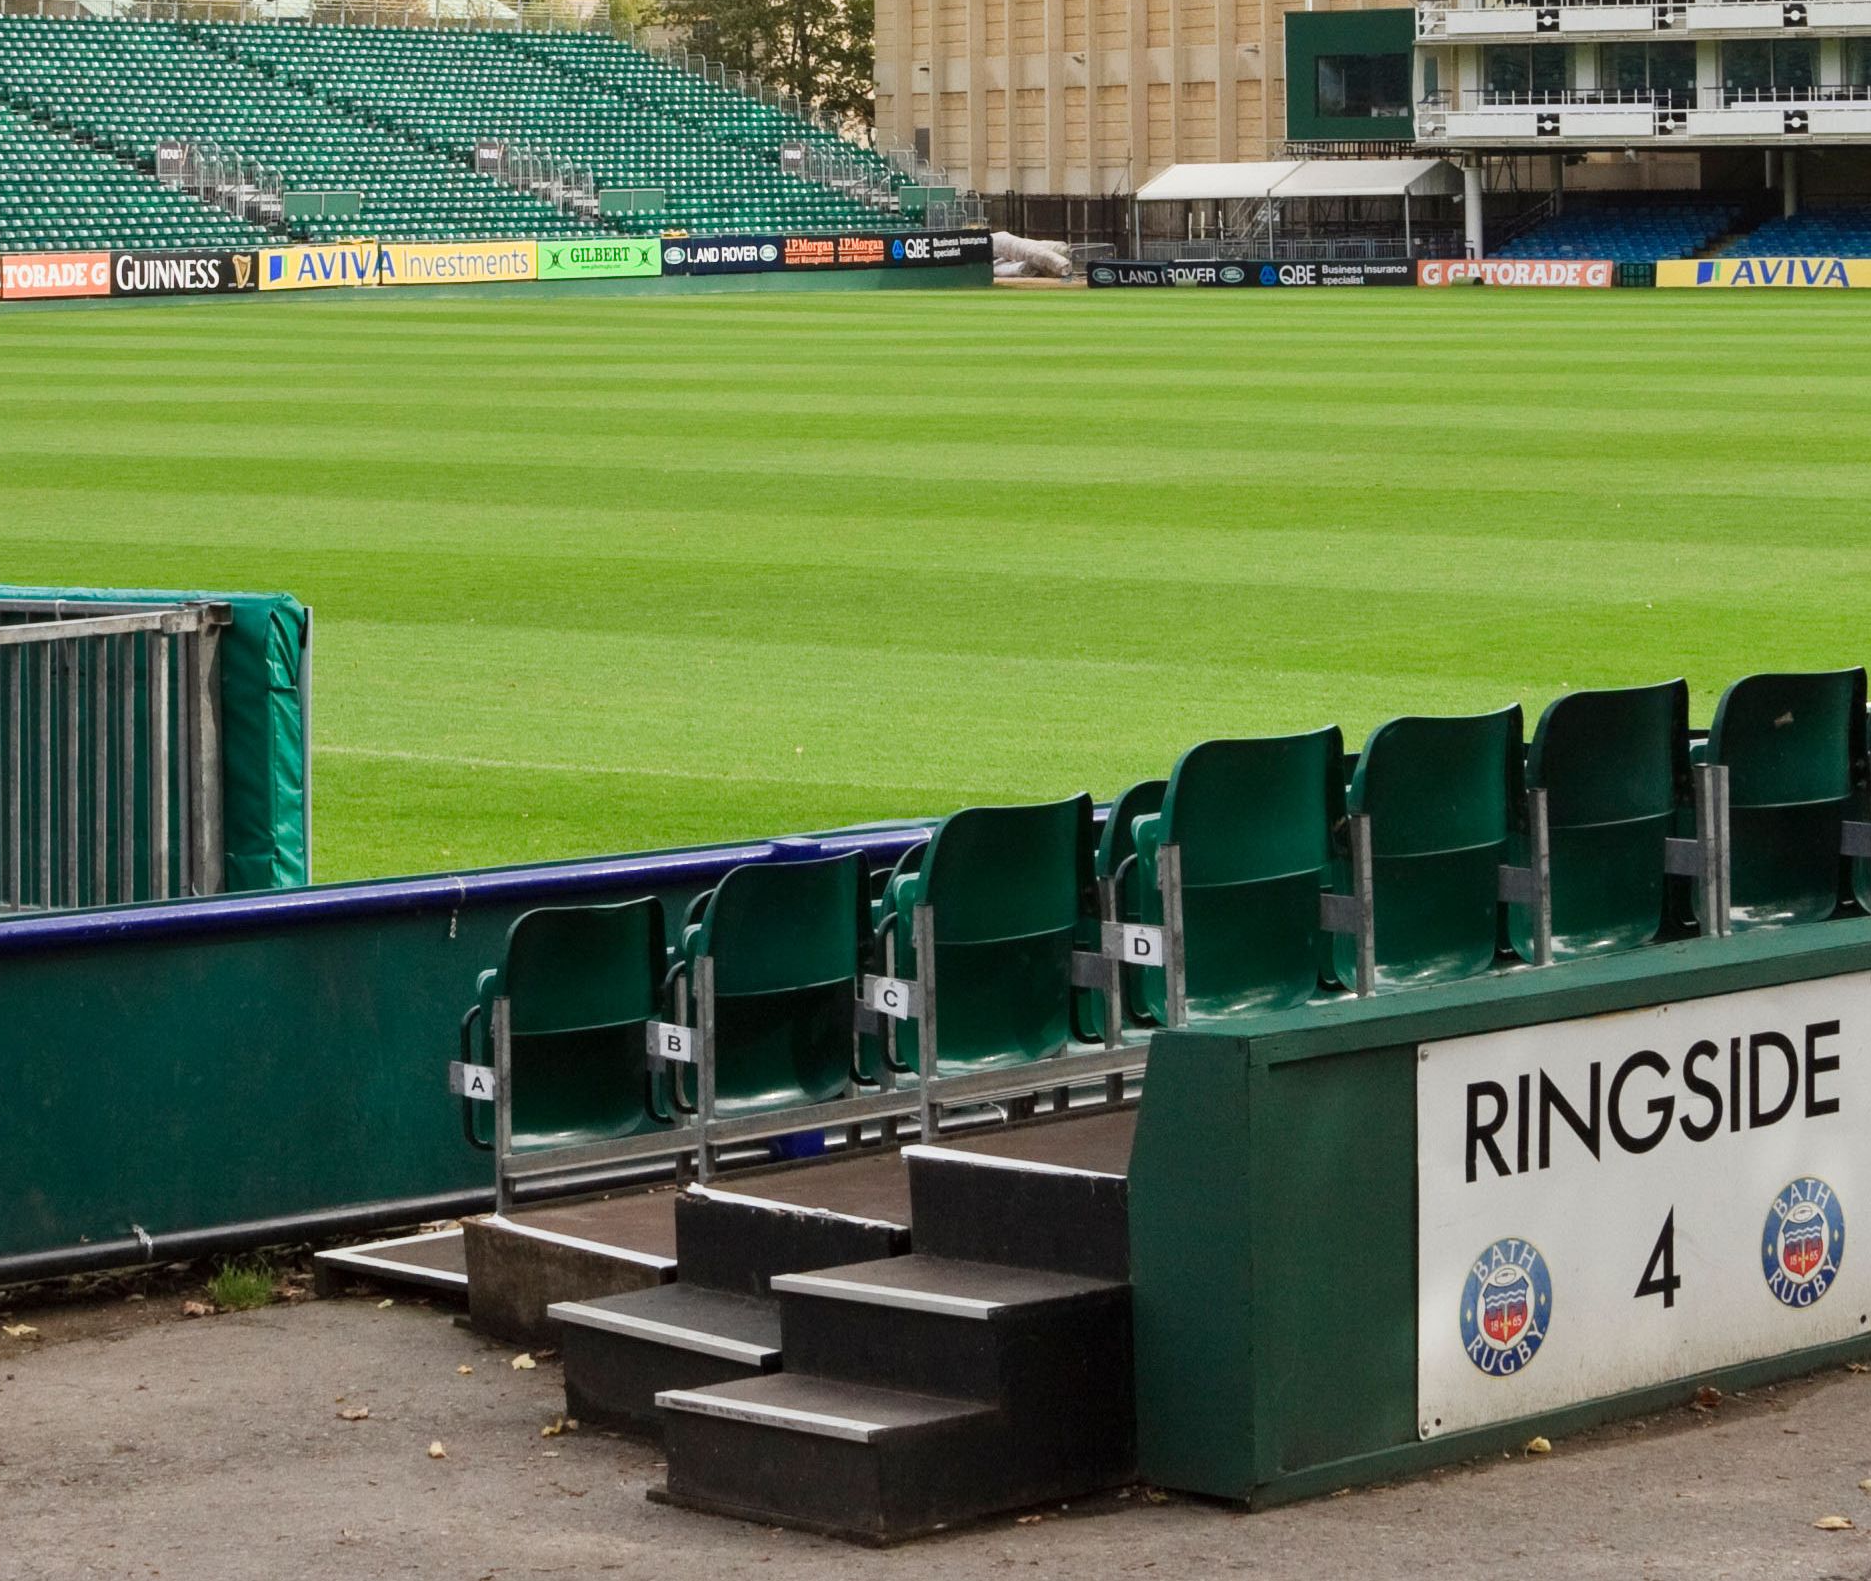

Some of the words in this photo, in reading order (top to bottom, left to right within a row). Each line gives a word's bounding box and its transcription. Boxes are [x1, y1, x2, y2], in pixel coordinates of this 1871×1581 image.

[570, 247, 630, 263] GILBERT
[687, 247, 719, 263] LAND
[721, 245, 758, 261] ROVER
[785, 239, 834, 255] J.P.Morgan
[838, 238, 884, 254] J.P.Morgan
[905, 239, 930, 259] QBE
[116, 255, 220, 291] GUINNESS
[297, 250, 396, 281] AVIVA
[403, 249, 528, 278] Investments
[1279, 265, 1316, 285] QBE
[1322, 264, 1361, 275] Business
[1364, 264, 1407, 274] insurance
[1447, 263, 1581, 285] GATORADE
[1731, 259, 1850, 288] AVIVA
[1119, 270, 1158, 284] LAND
[1322, 275, 1365, 286] specialist
[1133, 937, 1152, 957] D
[883, 988, 899, 1008] C
[668, 1034, 682, 1052] B
[470, 1076, 486, 1093] A
[1465, 1019, 1840, 1183] RINGSIDE
[1773, 1179, 1831, 1219] BATH
[1472, 1240, 1537, 1284] BATH
[1634, 1203, 1681, 1309] 4
[1768, 1254, 1837, 1306] RUGBY
[1468, 1318, 1545, 1374] RUGBY
